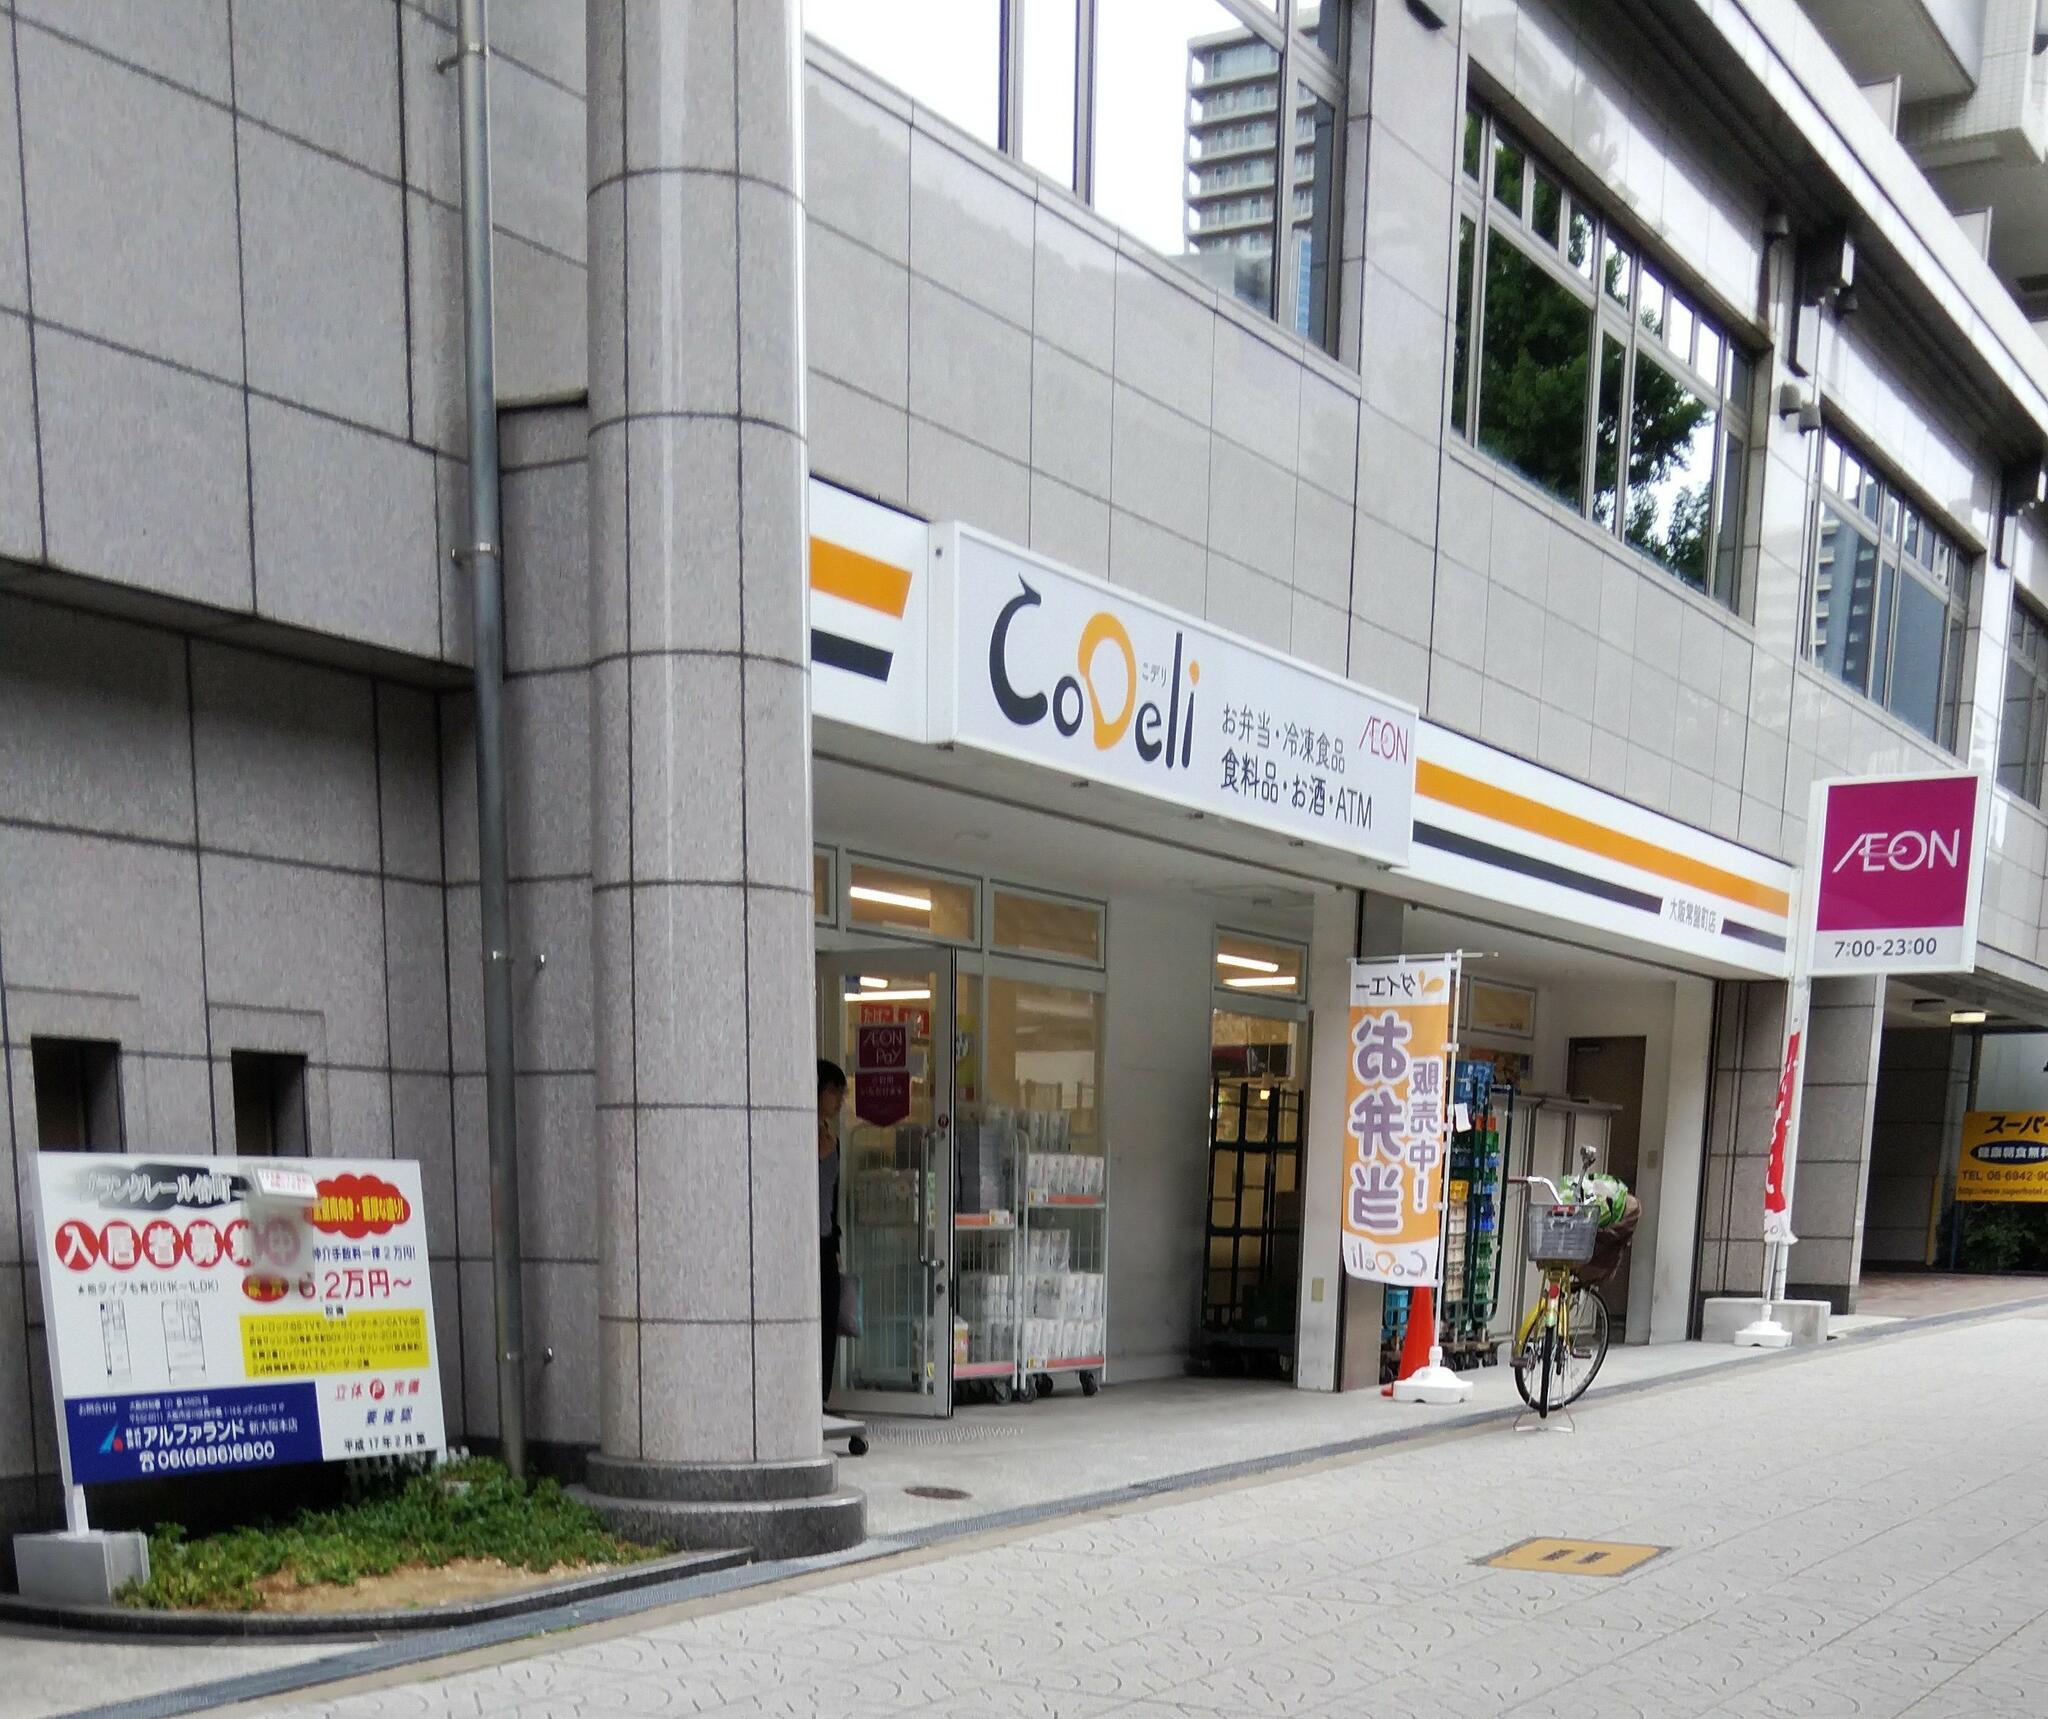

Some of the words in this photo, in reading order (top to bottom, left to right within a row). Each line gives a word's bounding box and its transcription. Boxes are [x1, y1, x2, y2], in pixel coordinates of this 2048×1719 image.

[988, 573, 1200, 770] CoDeli
[1221, 703, 1346, 775] お弁当・冷凍食品
[1221, 747, 1374, 830] 食料品・お酒・ATM
[1833, 937, 1938, 959] 7:00-23:00
[1962, 1171, 1982, 1181] TEL
[144, 1421, 245, 1447] アルファランド
